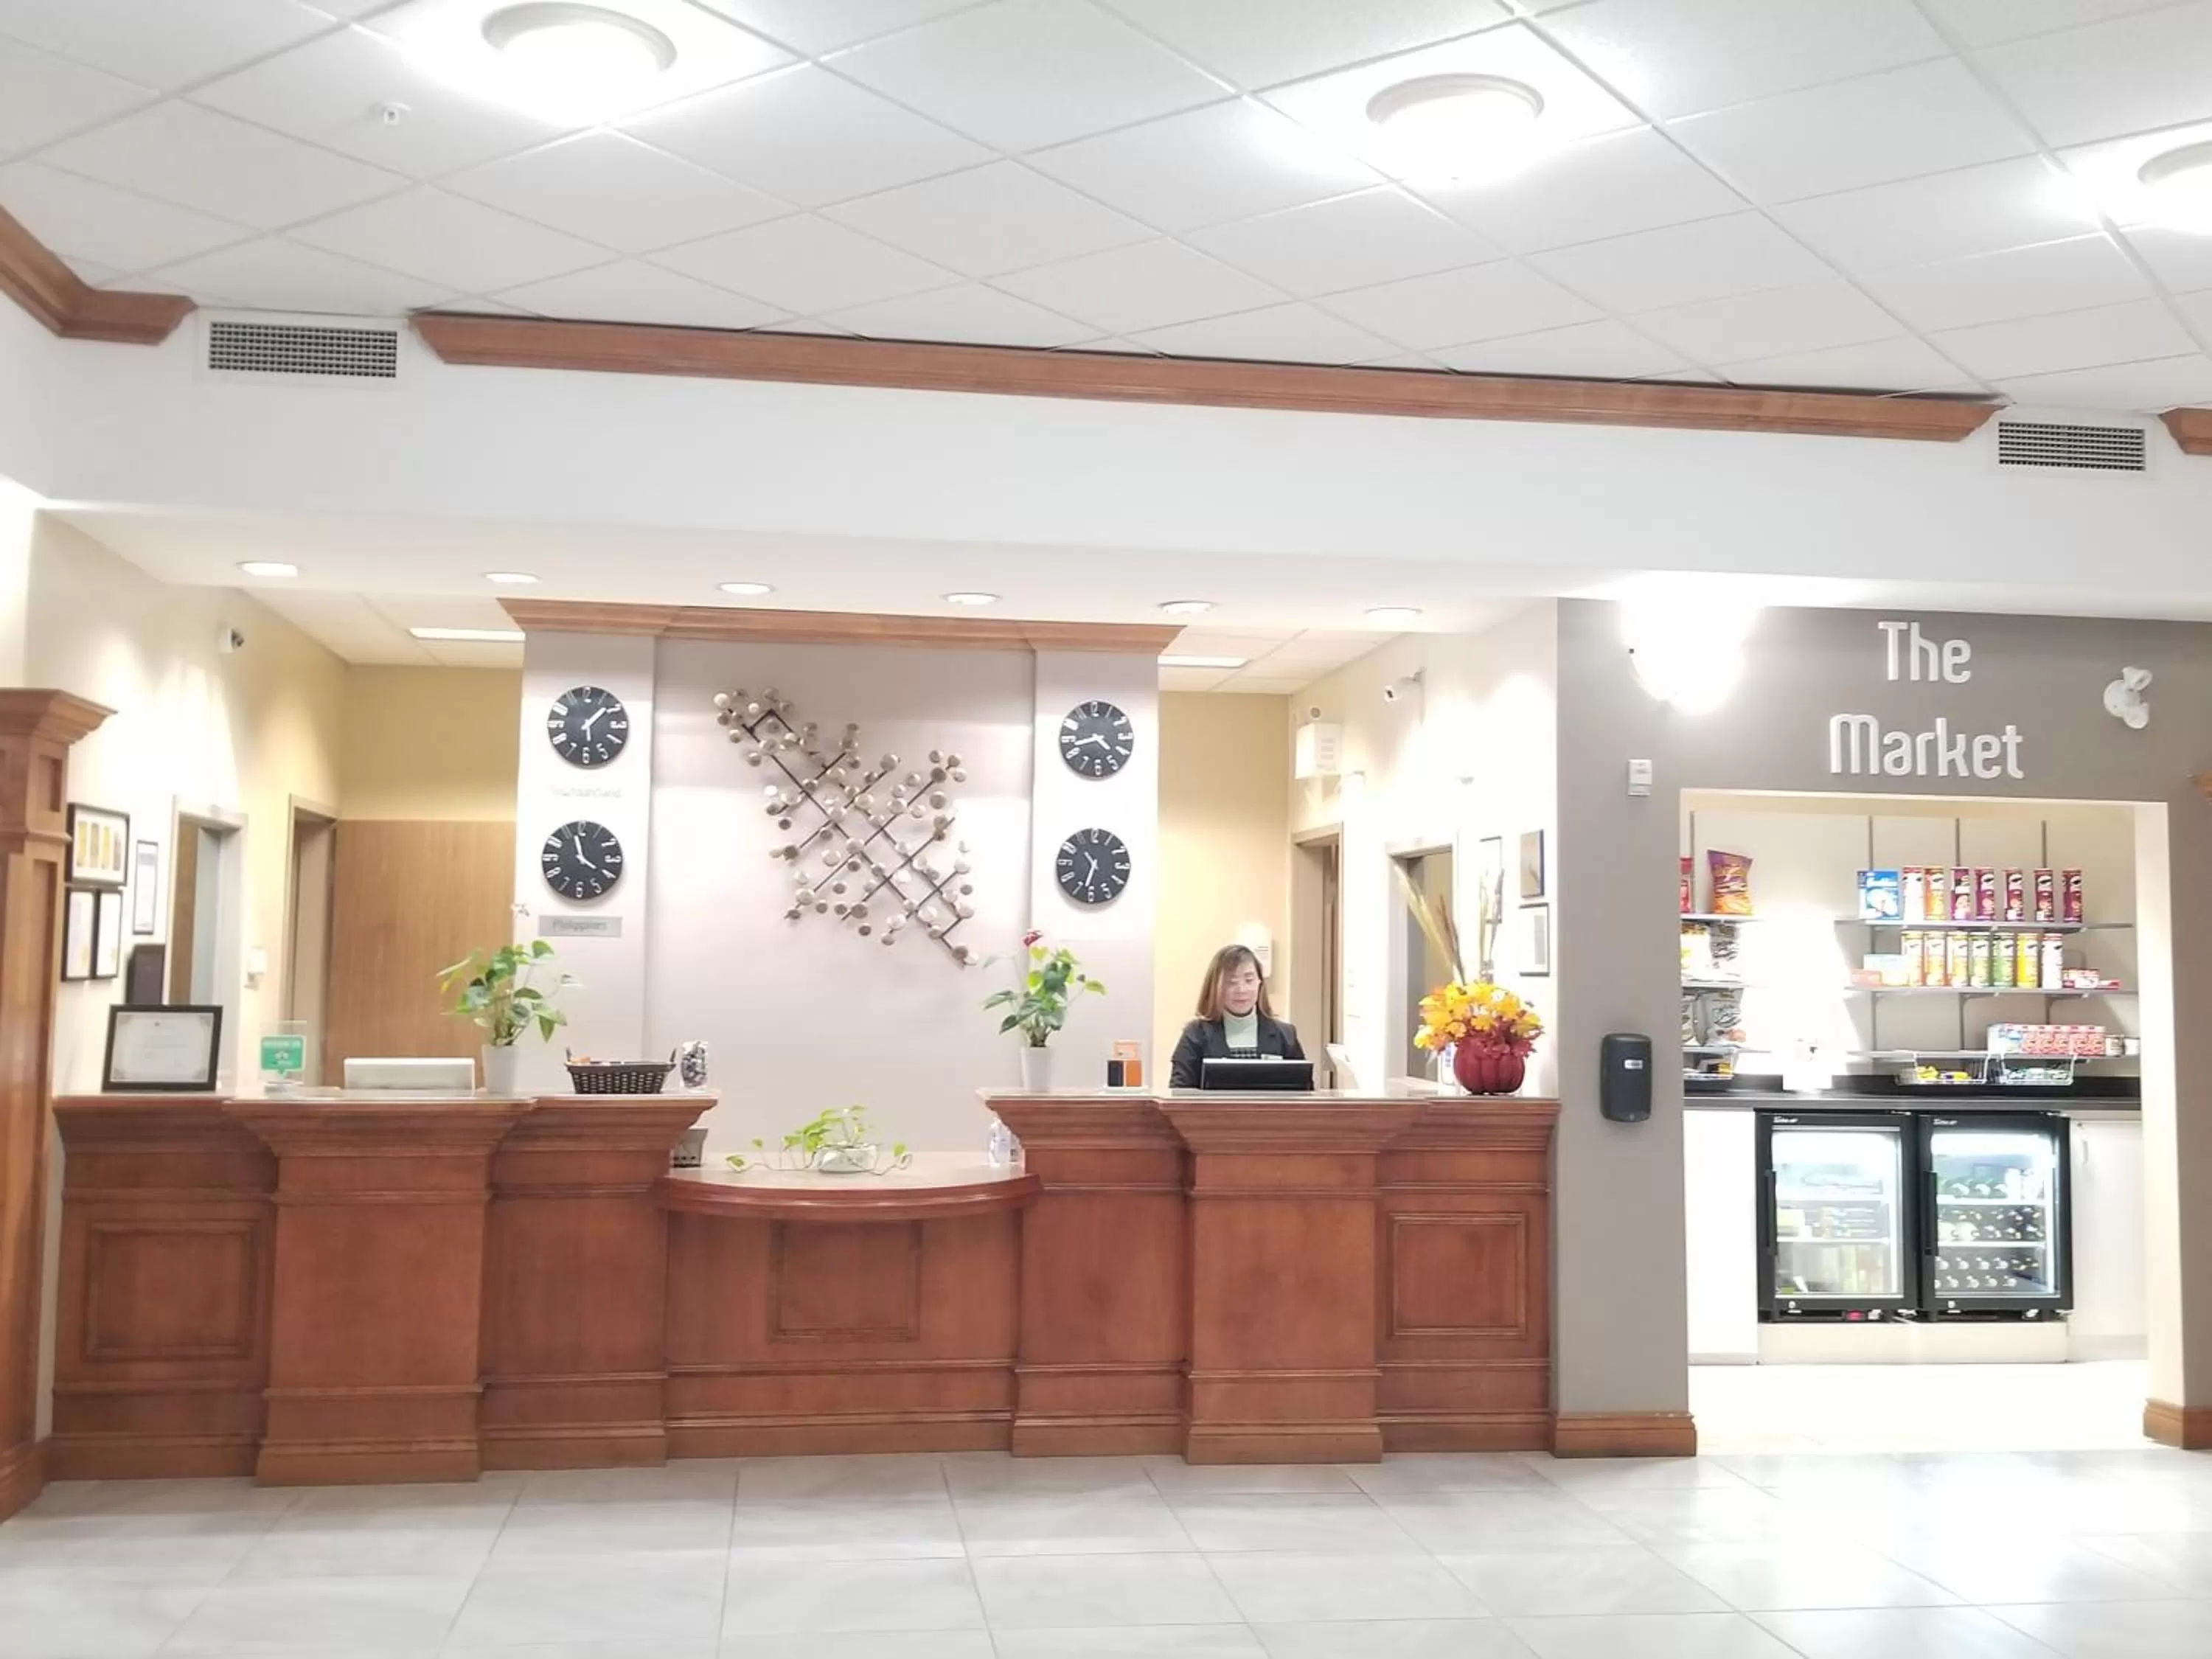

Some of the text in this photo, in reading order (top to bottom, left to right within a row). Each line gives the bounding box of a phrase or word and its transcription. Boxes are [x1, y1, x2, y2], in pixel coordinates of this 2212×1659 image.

[1877, 621, 1971, 684] The
[596, 742, 608, 759] 5
[1829, 712, 2025, 779] Market
[582, 747, 590, 764] 6
[1106, 754, 1119, 771] 5
[1094, 759, 1102, 776] 6
[575, 881, 584, 898] 6
[590, 877, 602, 894] 5
[1088, 886, 1095, 902] 6
[1100, 883, 1112, 899] 5
